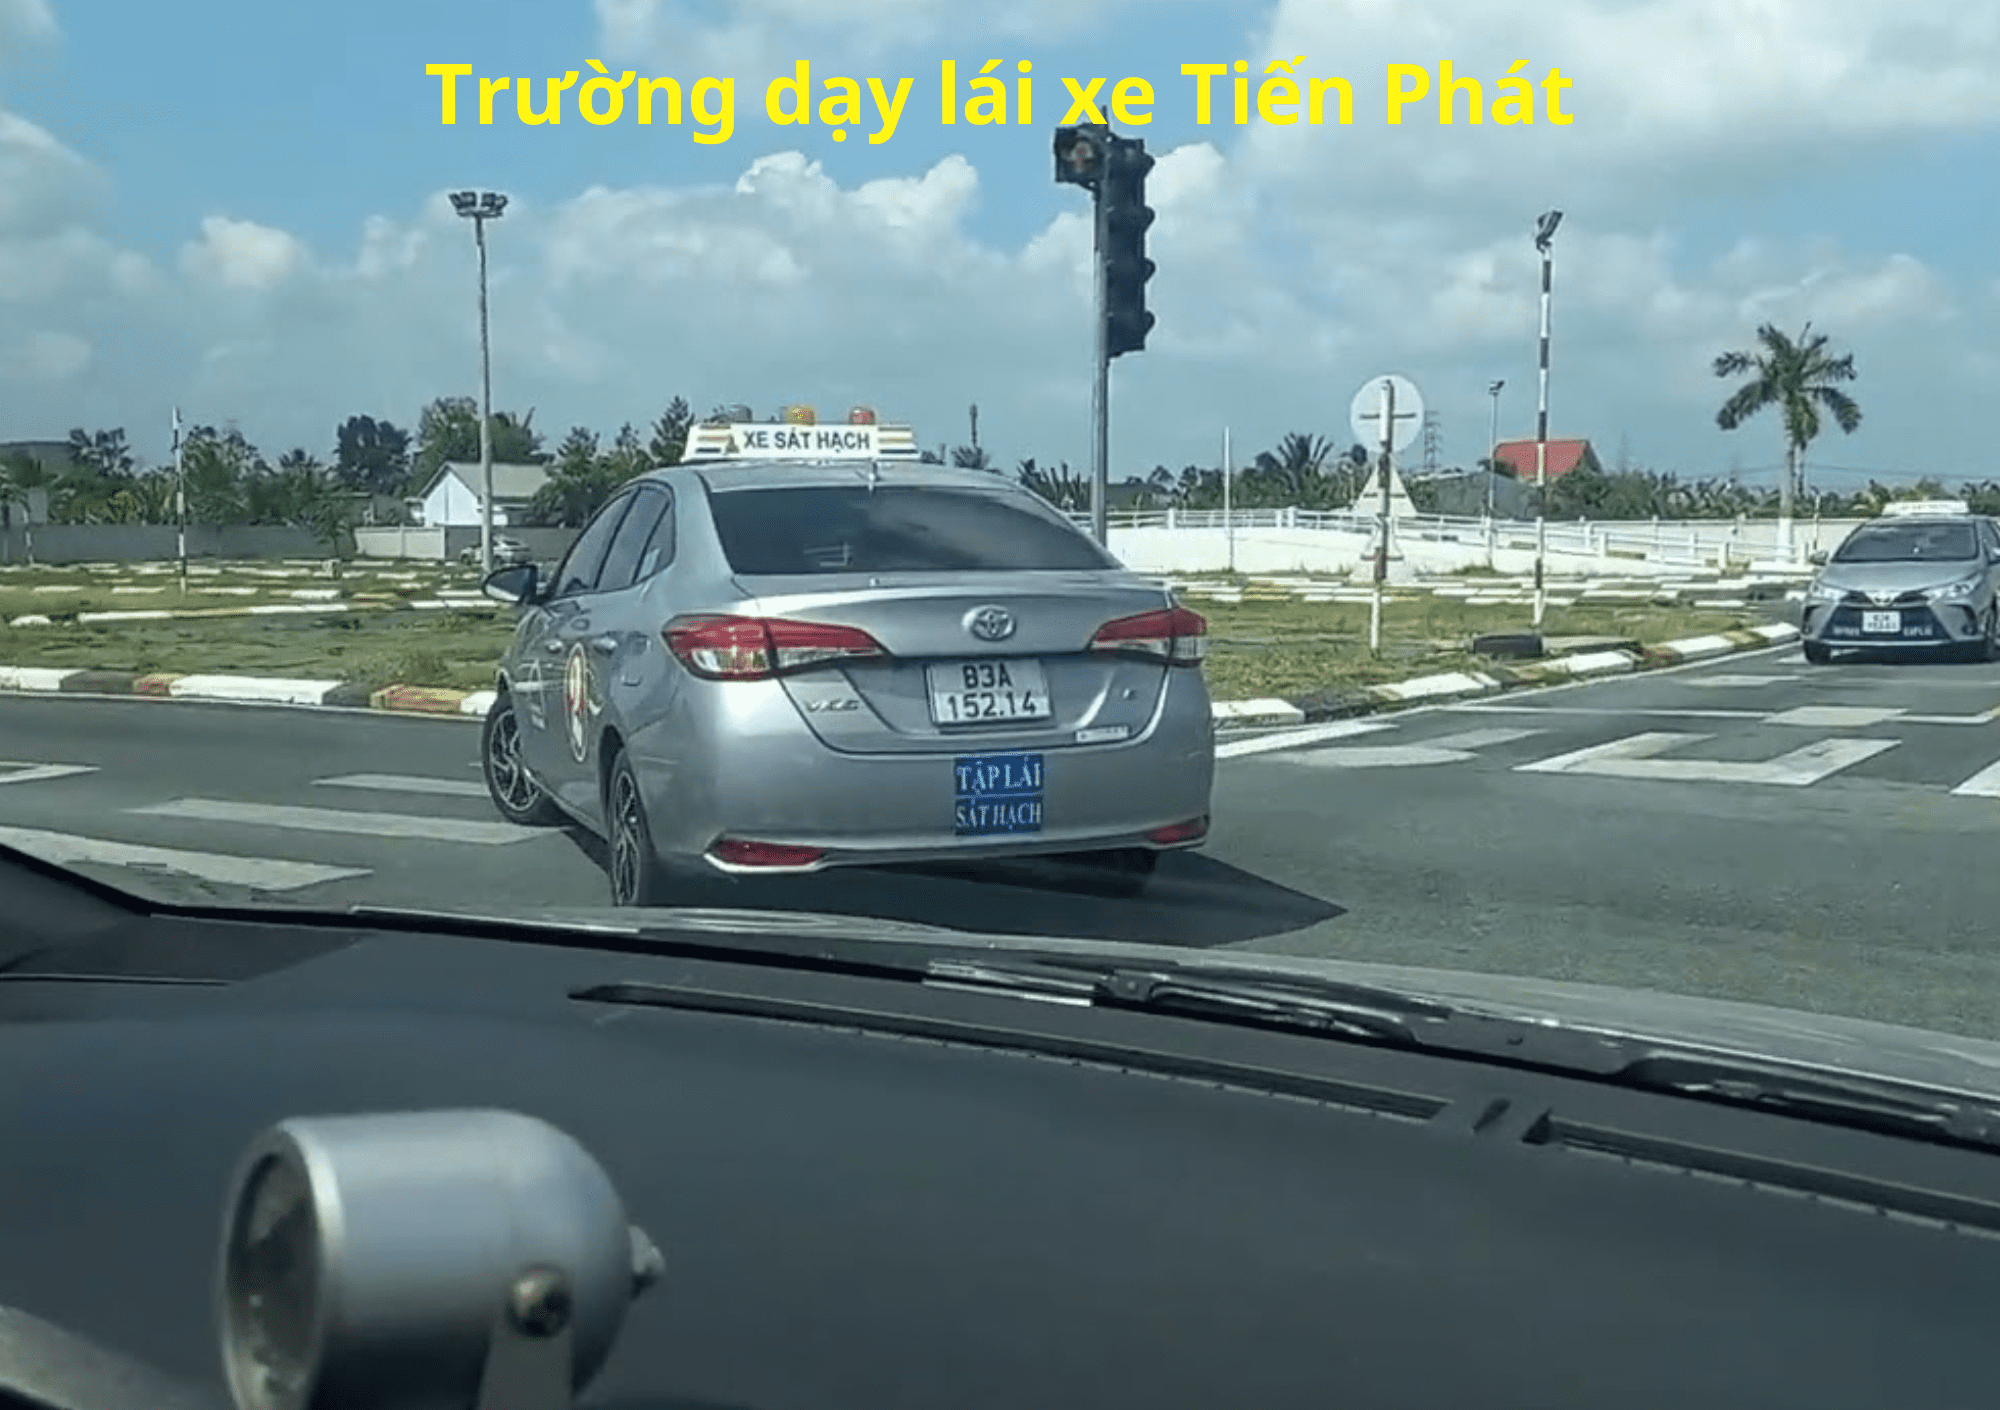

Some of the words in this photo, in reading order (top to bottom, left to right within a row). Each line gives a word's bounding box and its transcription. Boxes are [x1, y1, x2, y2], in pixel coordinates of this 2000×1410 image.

[744, 431, 769, 449] XE
[817, 432, 870, 453] HẠCH
[948, 690, 1036, 720] 152.14
